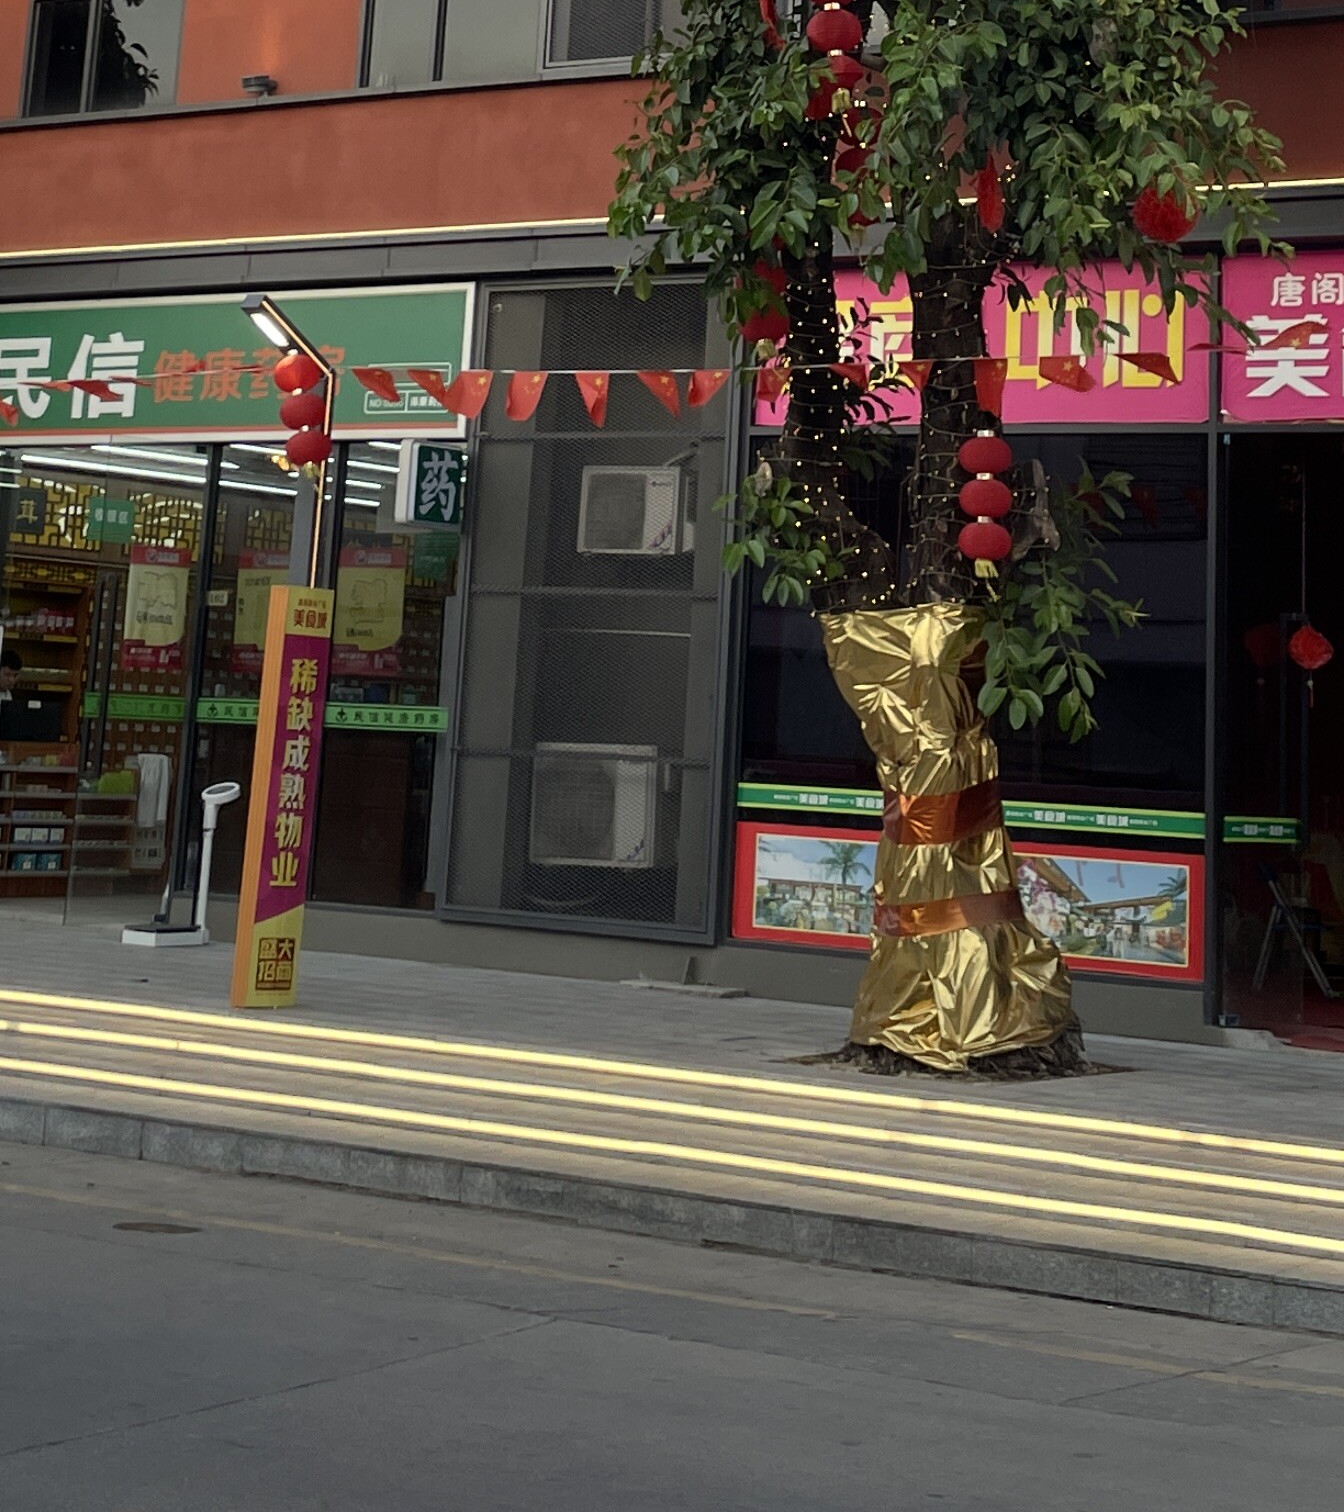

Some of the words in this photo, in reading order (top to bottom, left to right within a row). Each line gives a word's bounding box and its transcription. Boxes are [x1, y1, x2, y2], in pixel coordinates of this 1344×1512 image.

[419, 450, 458, 523] 药
[269, 658, 318, 886] 稀缺成熟物业
